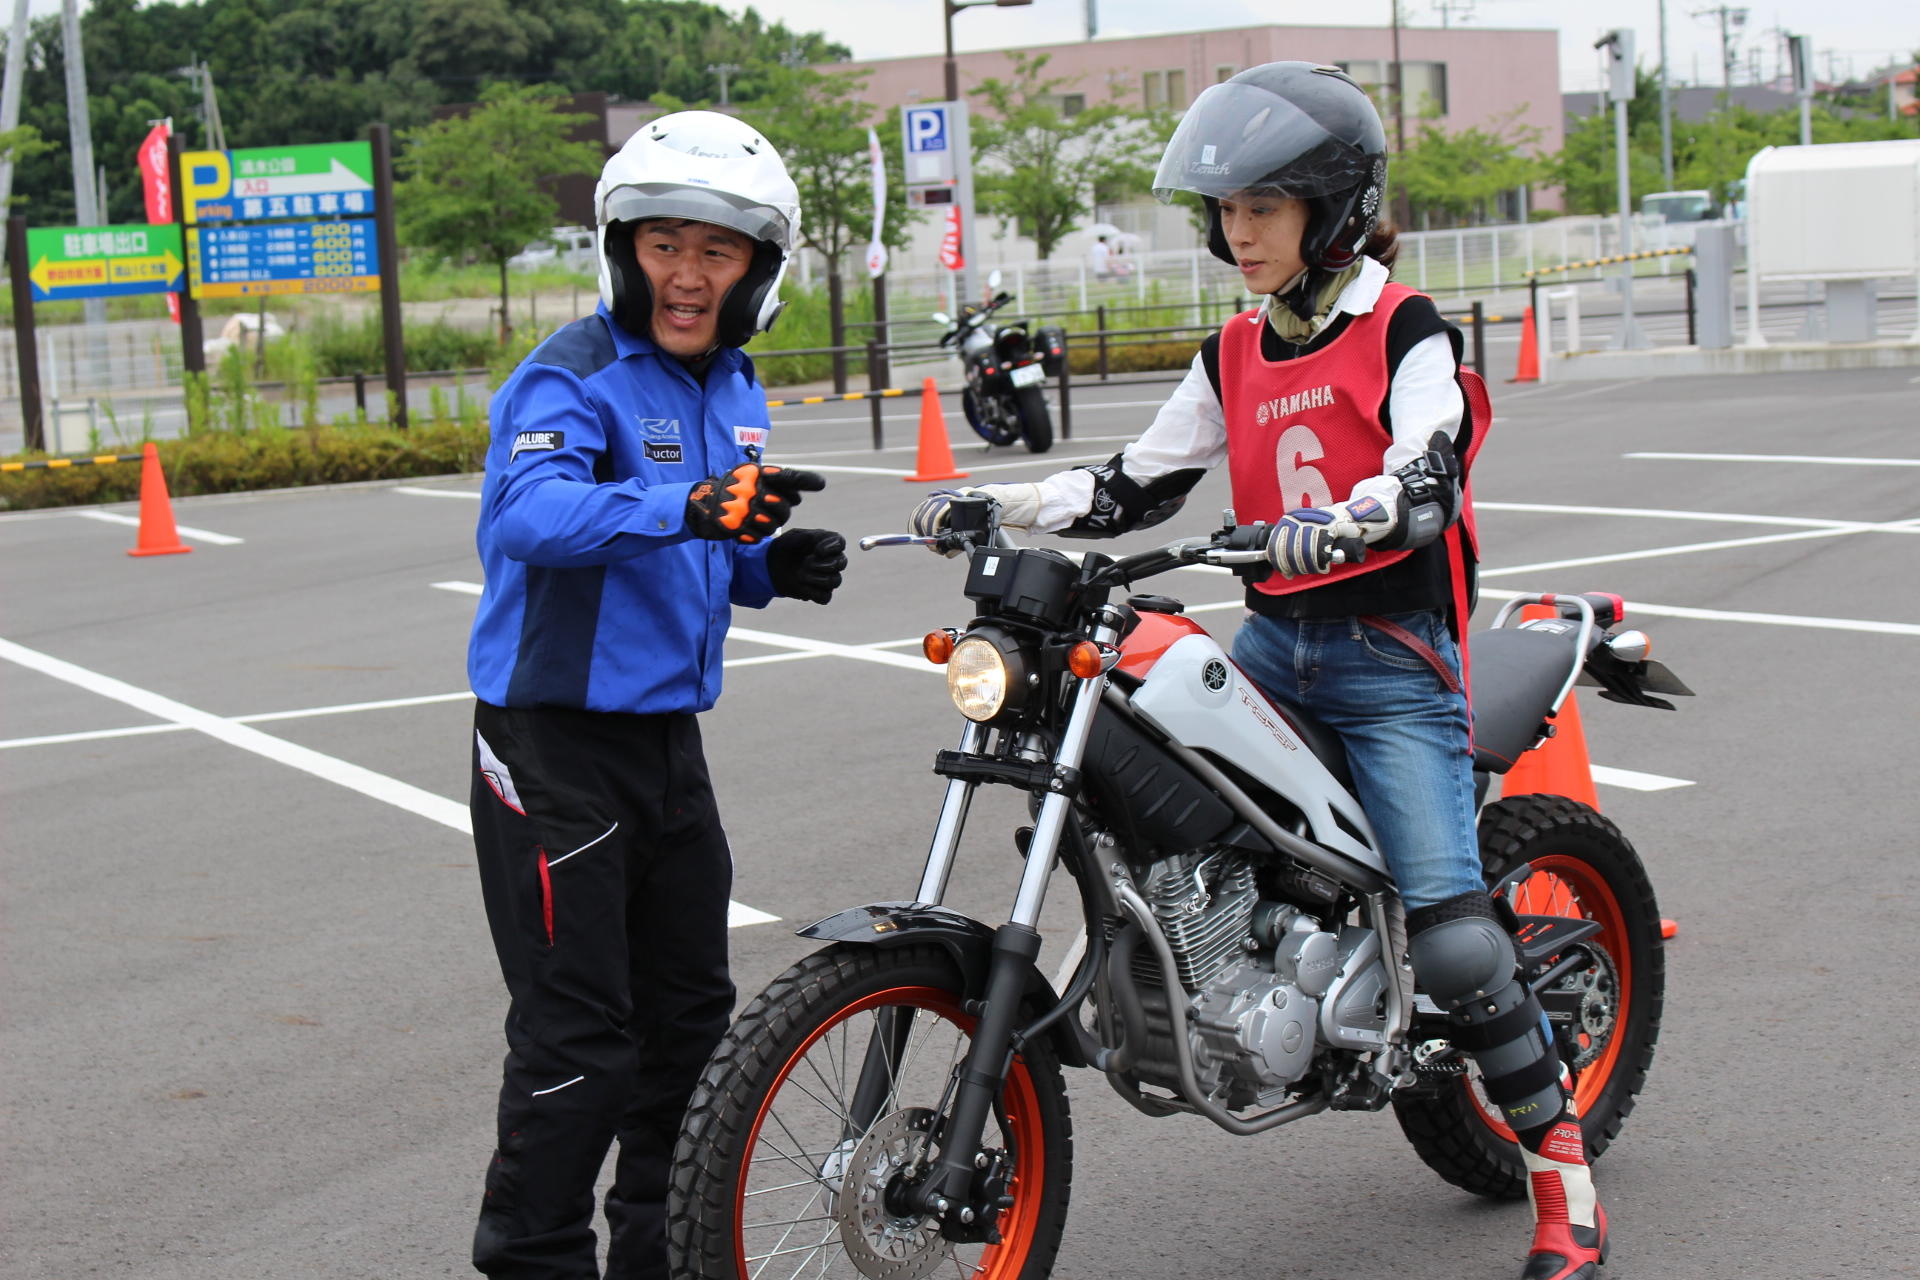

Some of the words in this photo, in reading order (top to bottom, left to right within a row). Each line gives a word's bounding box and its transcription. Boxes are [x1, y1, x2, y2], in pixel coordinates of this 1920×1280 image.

[910, 110, 941, 151] P
[243, 178, 269, 196] 入口
[1269, 384, 1335, 420] YAMAHA
[1276, 424, 1333, 510] 6
